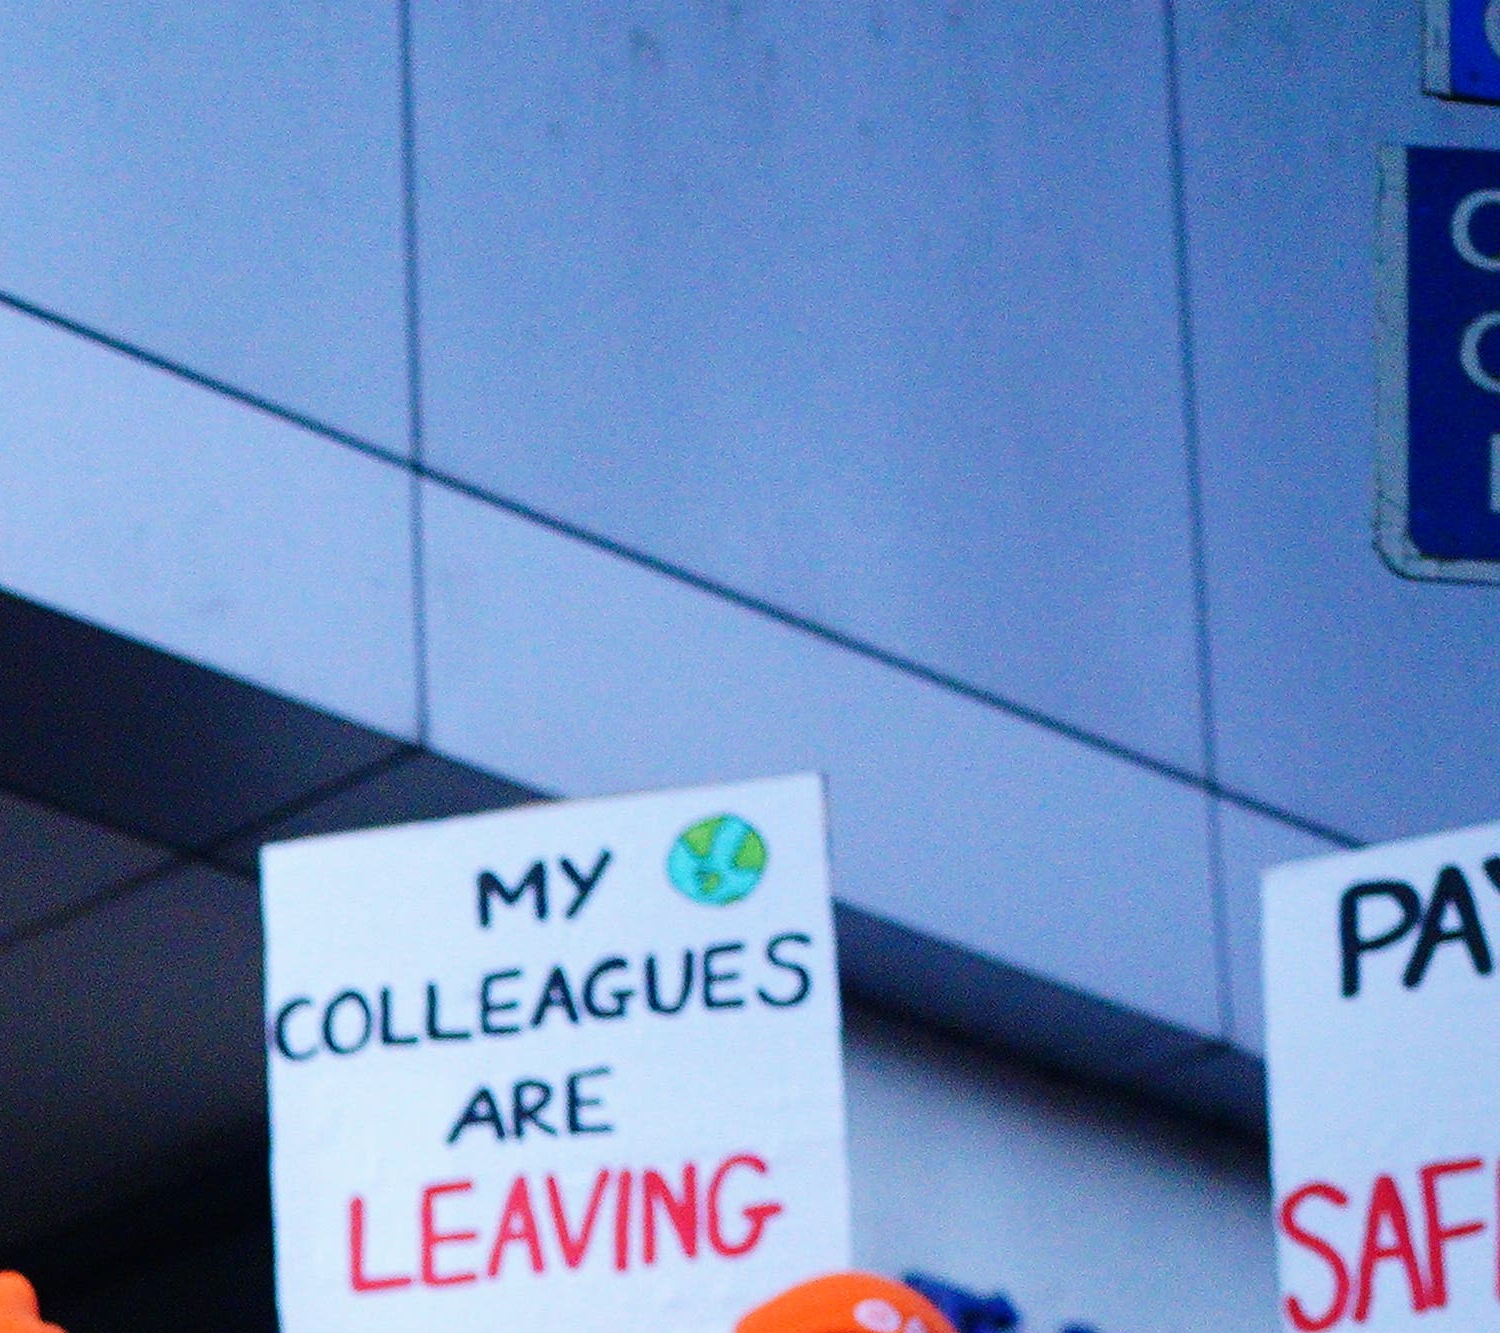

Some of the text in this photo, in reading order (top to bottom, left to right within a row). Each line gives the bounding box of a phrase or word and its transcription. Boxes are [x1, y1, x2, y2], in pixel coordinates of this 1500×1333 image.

[475, 849, 613, 929] MY
[274, 932, 812, 1063] COLLEAGUES
[446, 1065, 614, 1145] ARE
[348, 1153, 783, 1293] LEAVING
